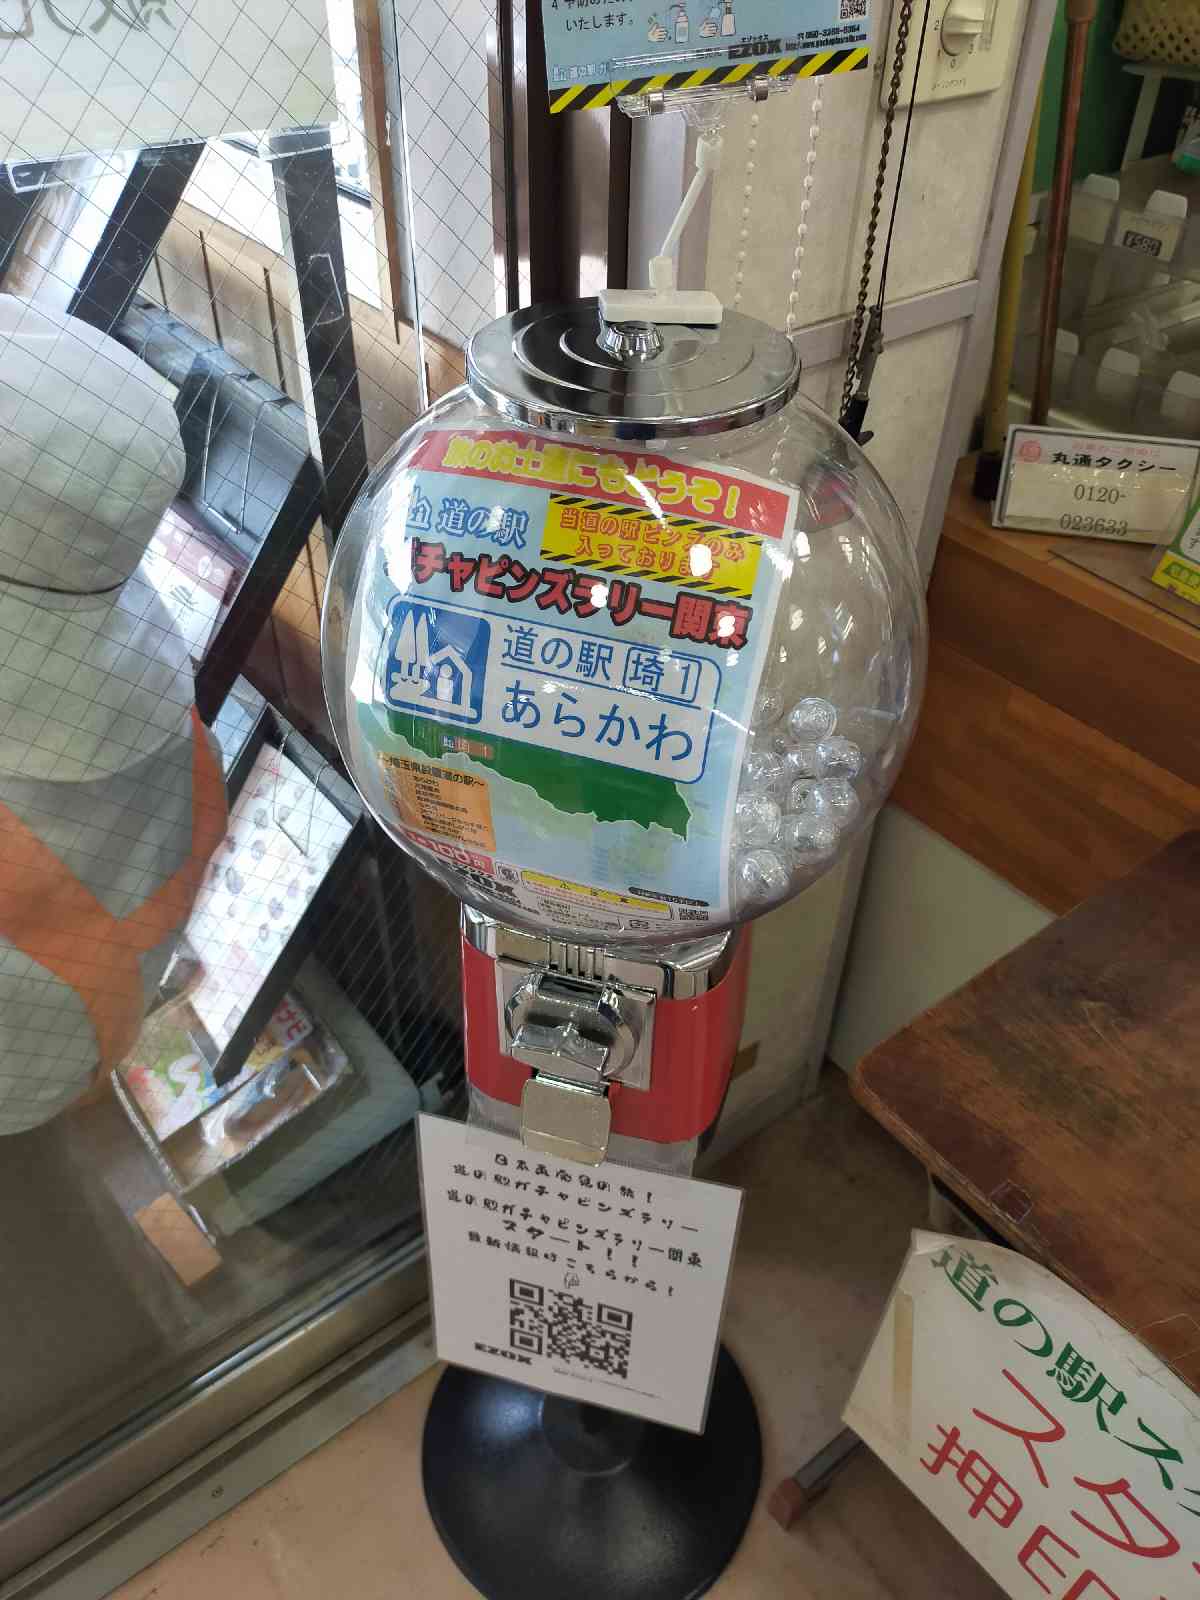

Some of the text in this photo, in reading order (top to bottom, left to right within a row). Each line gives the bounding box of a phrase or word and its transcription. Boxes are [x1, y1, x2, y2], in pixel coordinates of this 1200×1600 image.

[566, 12, 633, 31] いたします。
[1051, 451, 1177, 472] 丸通タクシー
[1073, 484, 1127, 505] 0120-
[436, 496, 528, 549] 道の駅
[1059, 513, 1129, 537] 023633
[410, 537, 754, 650] チャピンズラリー関東
[502, 624, 613, 681] 道の駅
[628, 650, 692, 695] 埼1
[501, 680, 693, 761] あらかわ
[930, 1244, 1200, 1517] 道の駅ス
[972, 1368, 1200, 1600] スタ
